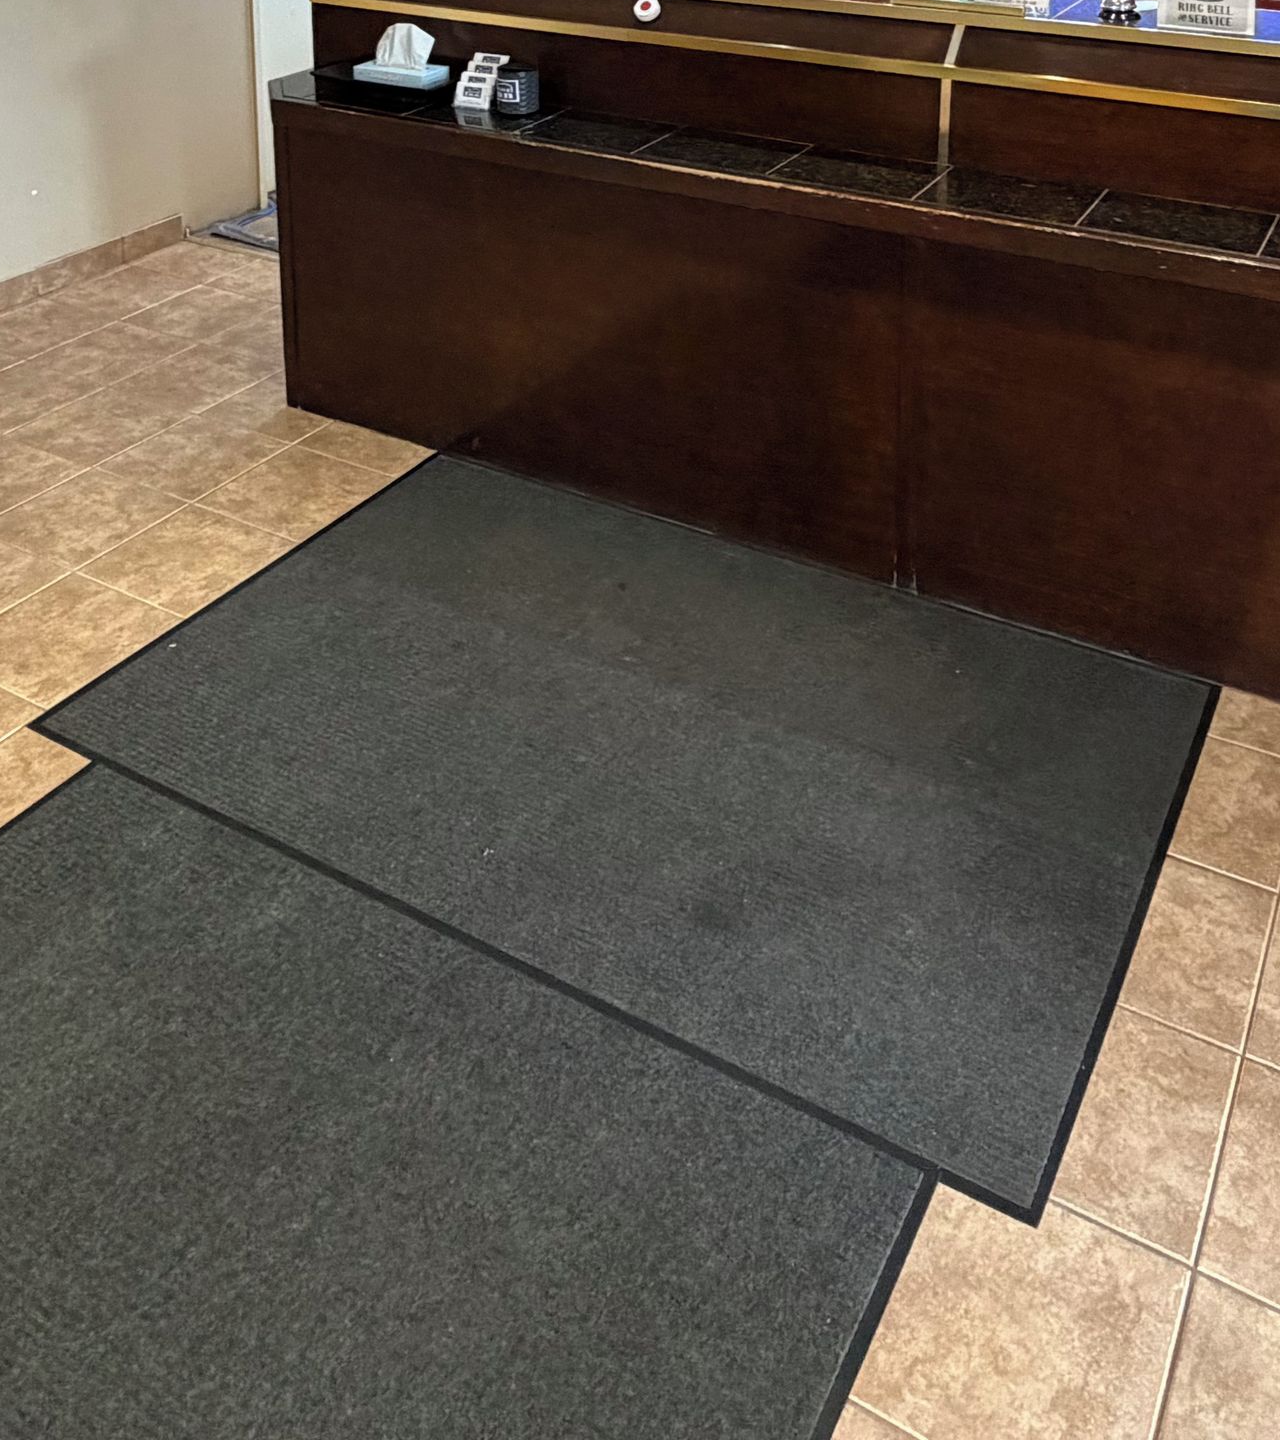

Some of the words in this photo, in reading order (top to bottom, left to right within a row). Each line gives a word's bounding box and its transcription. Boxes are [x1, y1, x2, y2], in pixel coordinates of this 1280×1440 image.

[1178, 1, 1204, 13] RING
[1207, 5, 1233, 16] BELL
[1188, 14, 1233, 27] SERVICE
